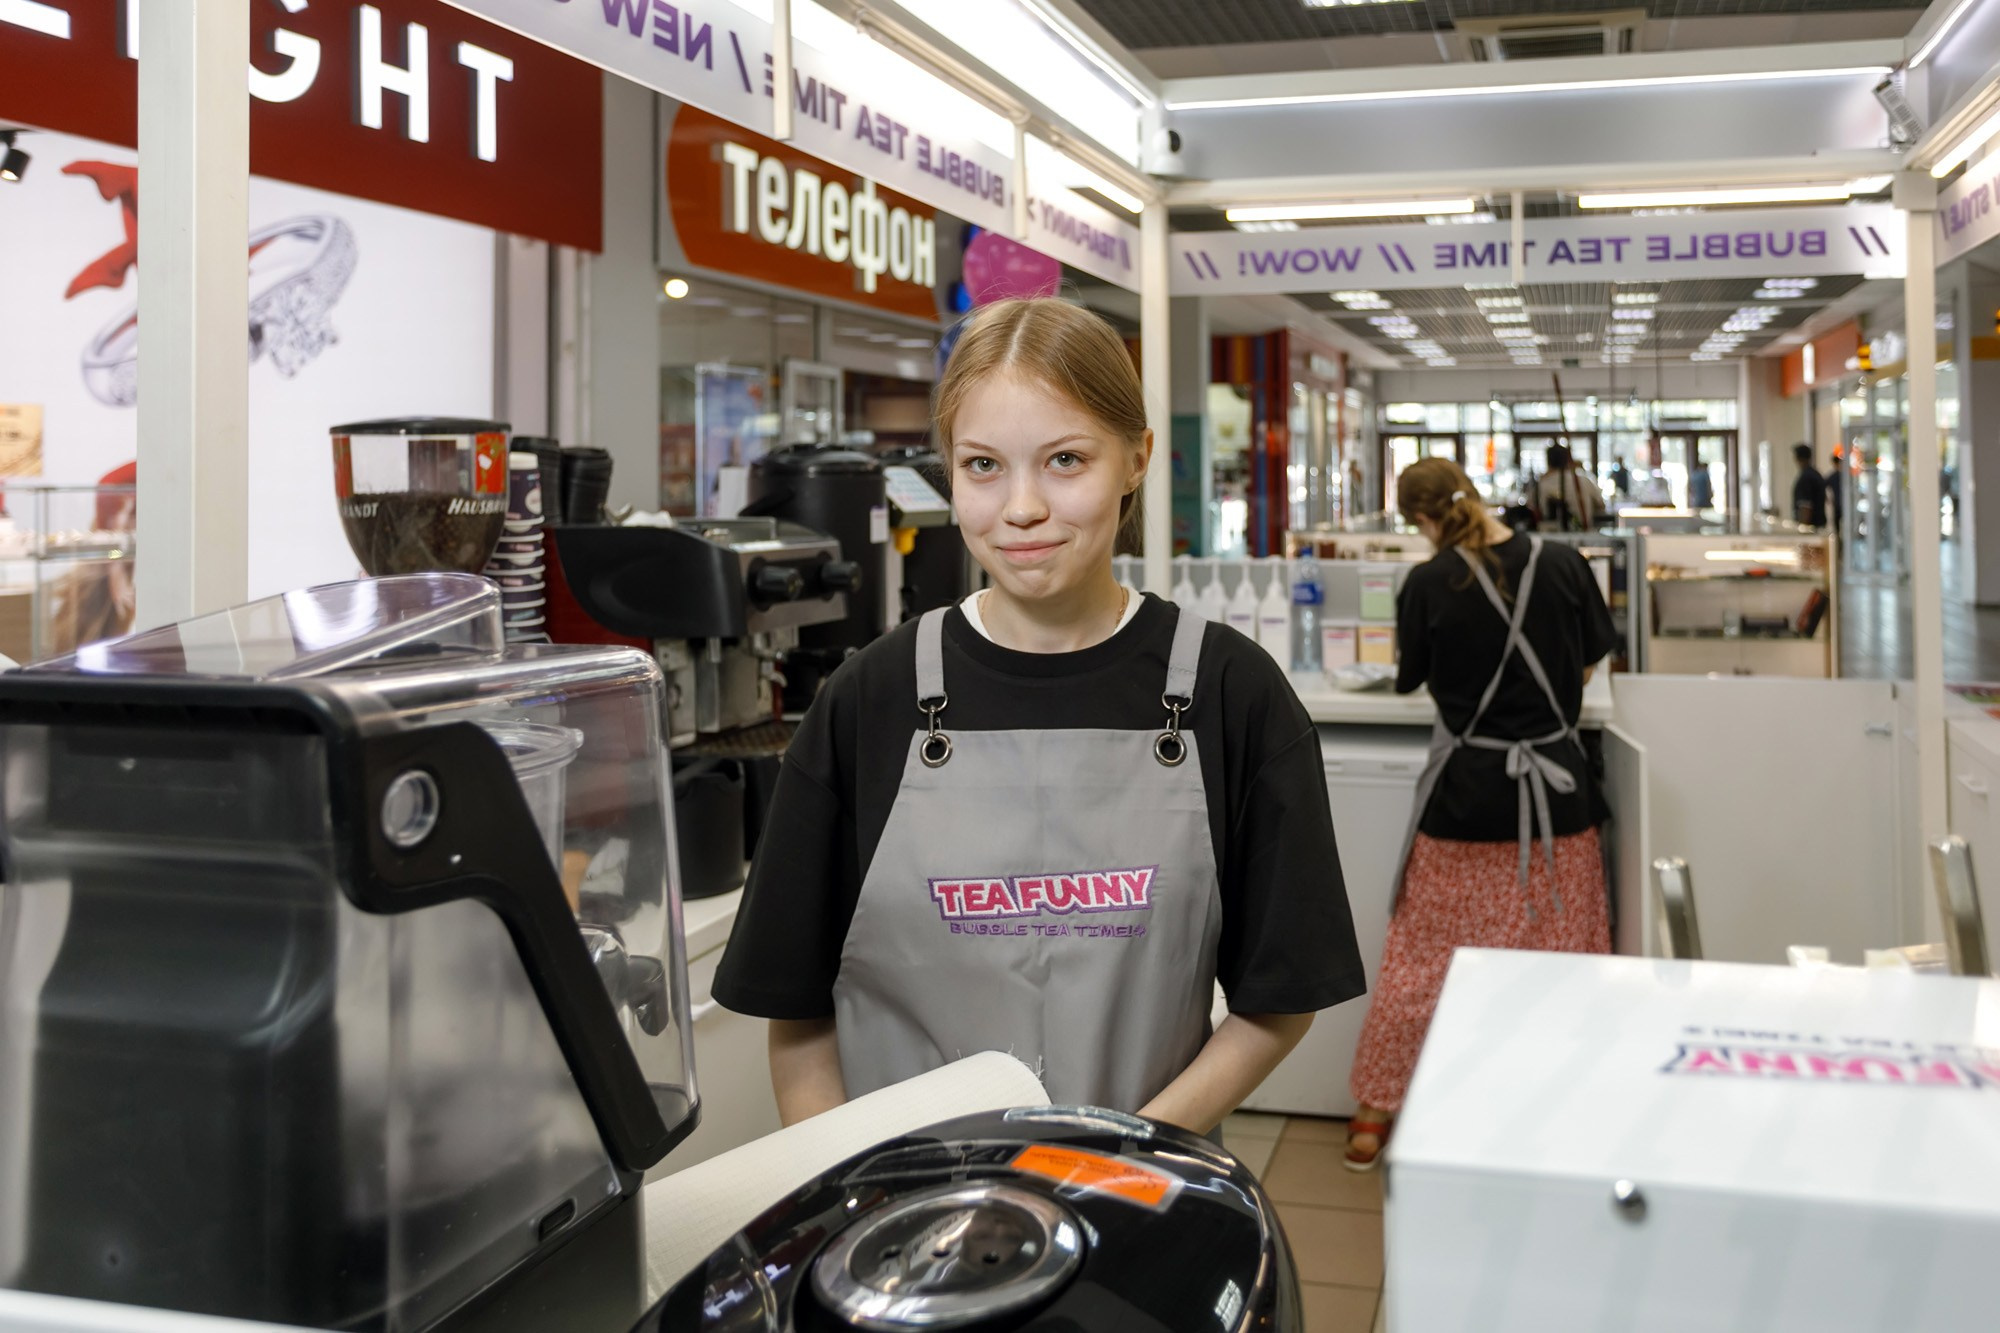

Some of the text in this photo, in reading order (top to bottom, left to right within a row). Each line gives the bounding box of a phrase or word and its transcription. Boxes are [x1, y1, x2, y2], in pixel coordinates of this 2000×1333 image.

[722, 141, 936, 294] телефон
[950, 922, 1028, 936] BUBBLE
[1031, 924, 1071, 936] TEA
